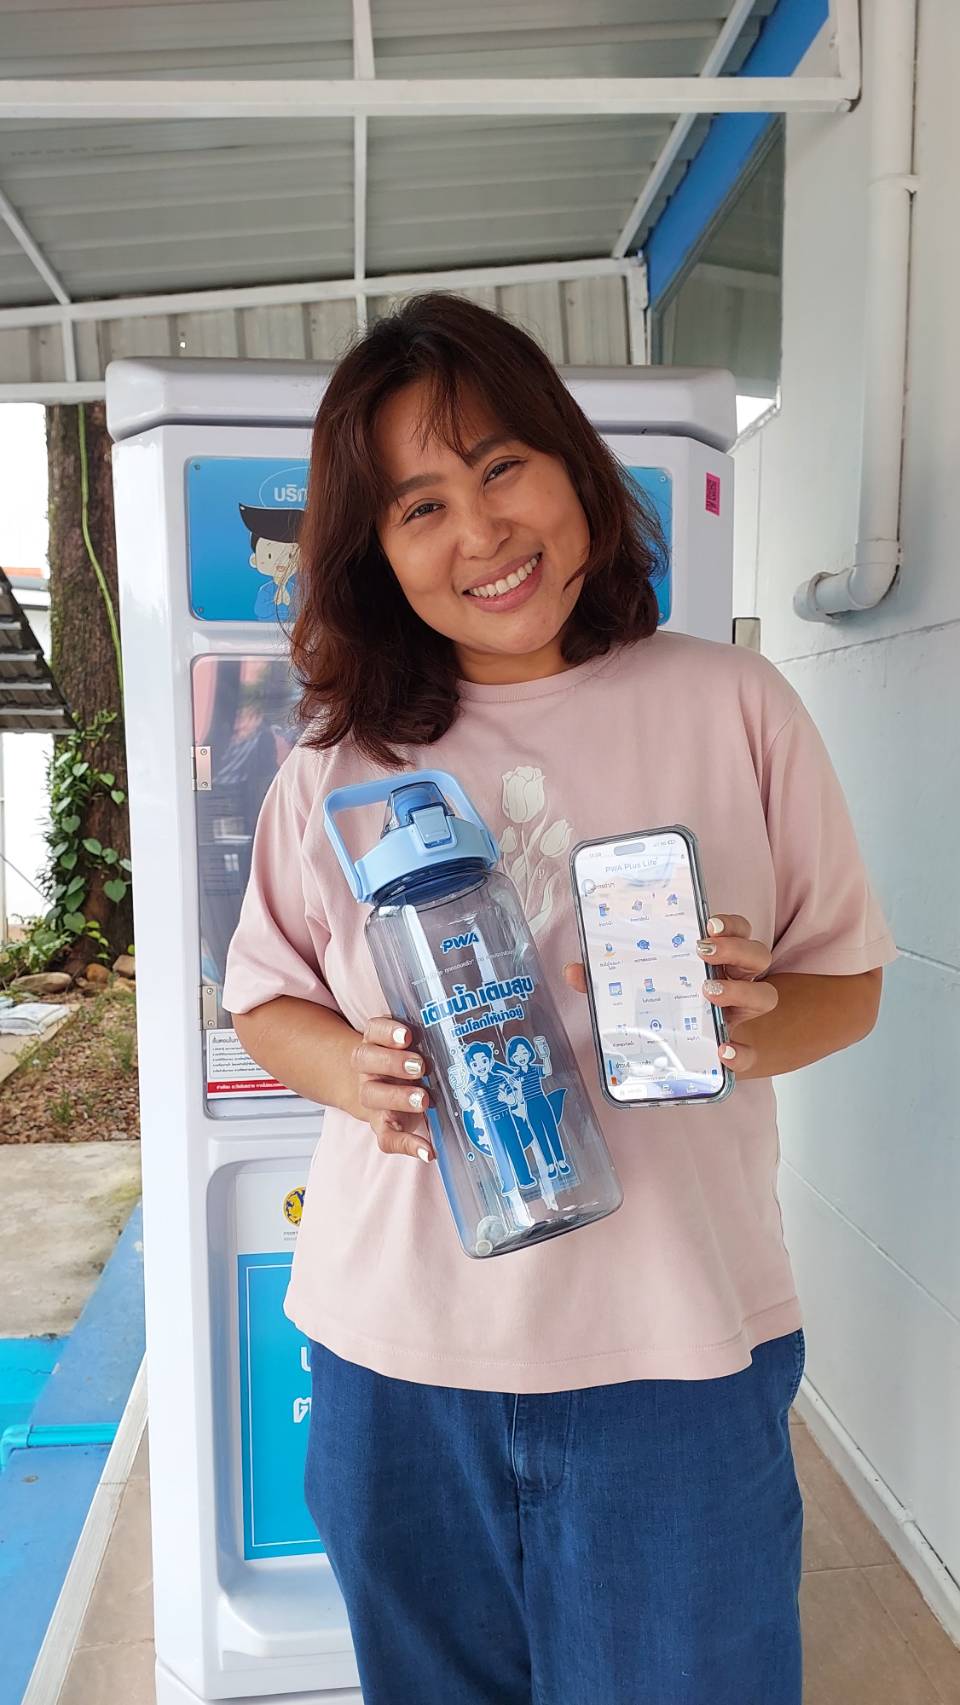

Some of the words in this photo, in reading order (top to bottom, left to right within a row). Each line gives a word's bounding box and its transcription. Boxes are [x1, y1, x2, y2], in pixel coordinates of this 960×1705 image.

[605, 863, 623, 874] PWA
[624, 860, 642, 871] Plus
[440, 932, 480, 953] PWA
[421, 985, 478, 1026] เติมน้ำ
[479, 976, 534, 1001] เติมสุข
